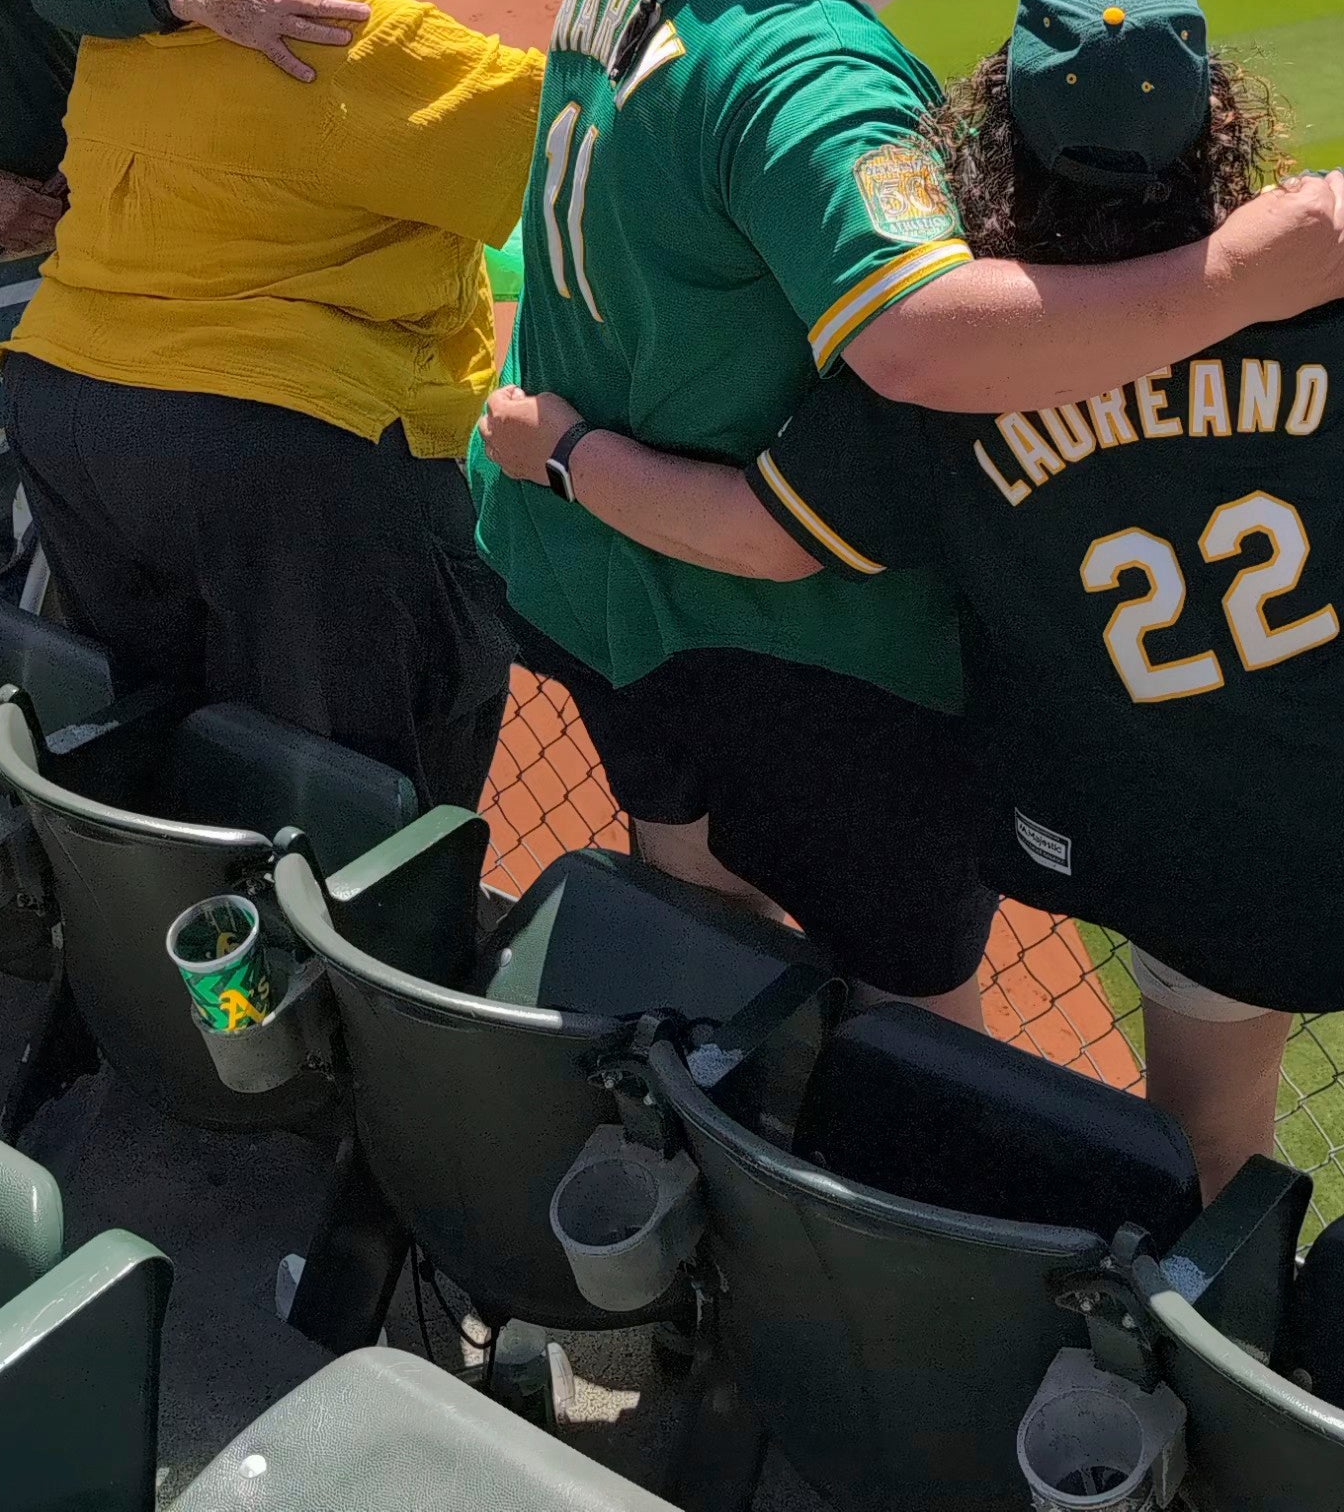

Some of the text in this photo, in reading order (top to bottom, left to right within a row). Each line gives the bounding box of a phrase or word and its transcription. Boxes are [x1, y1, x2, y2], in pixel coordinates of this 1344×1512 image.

[875, 175, 935, 219] 50
[972, 358, 1328, 507] LAUREANO
[1079, 489, 1340, 703] 22
